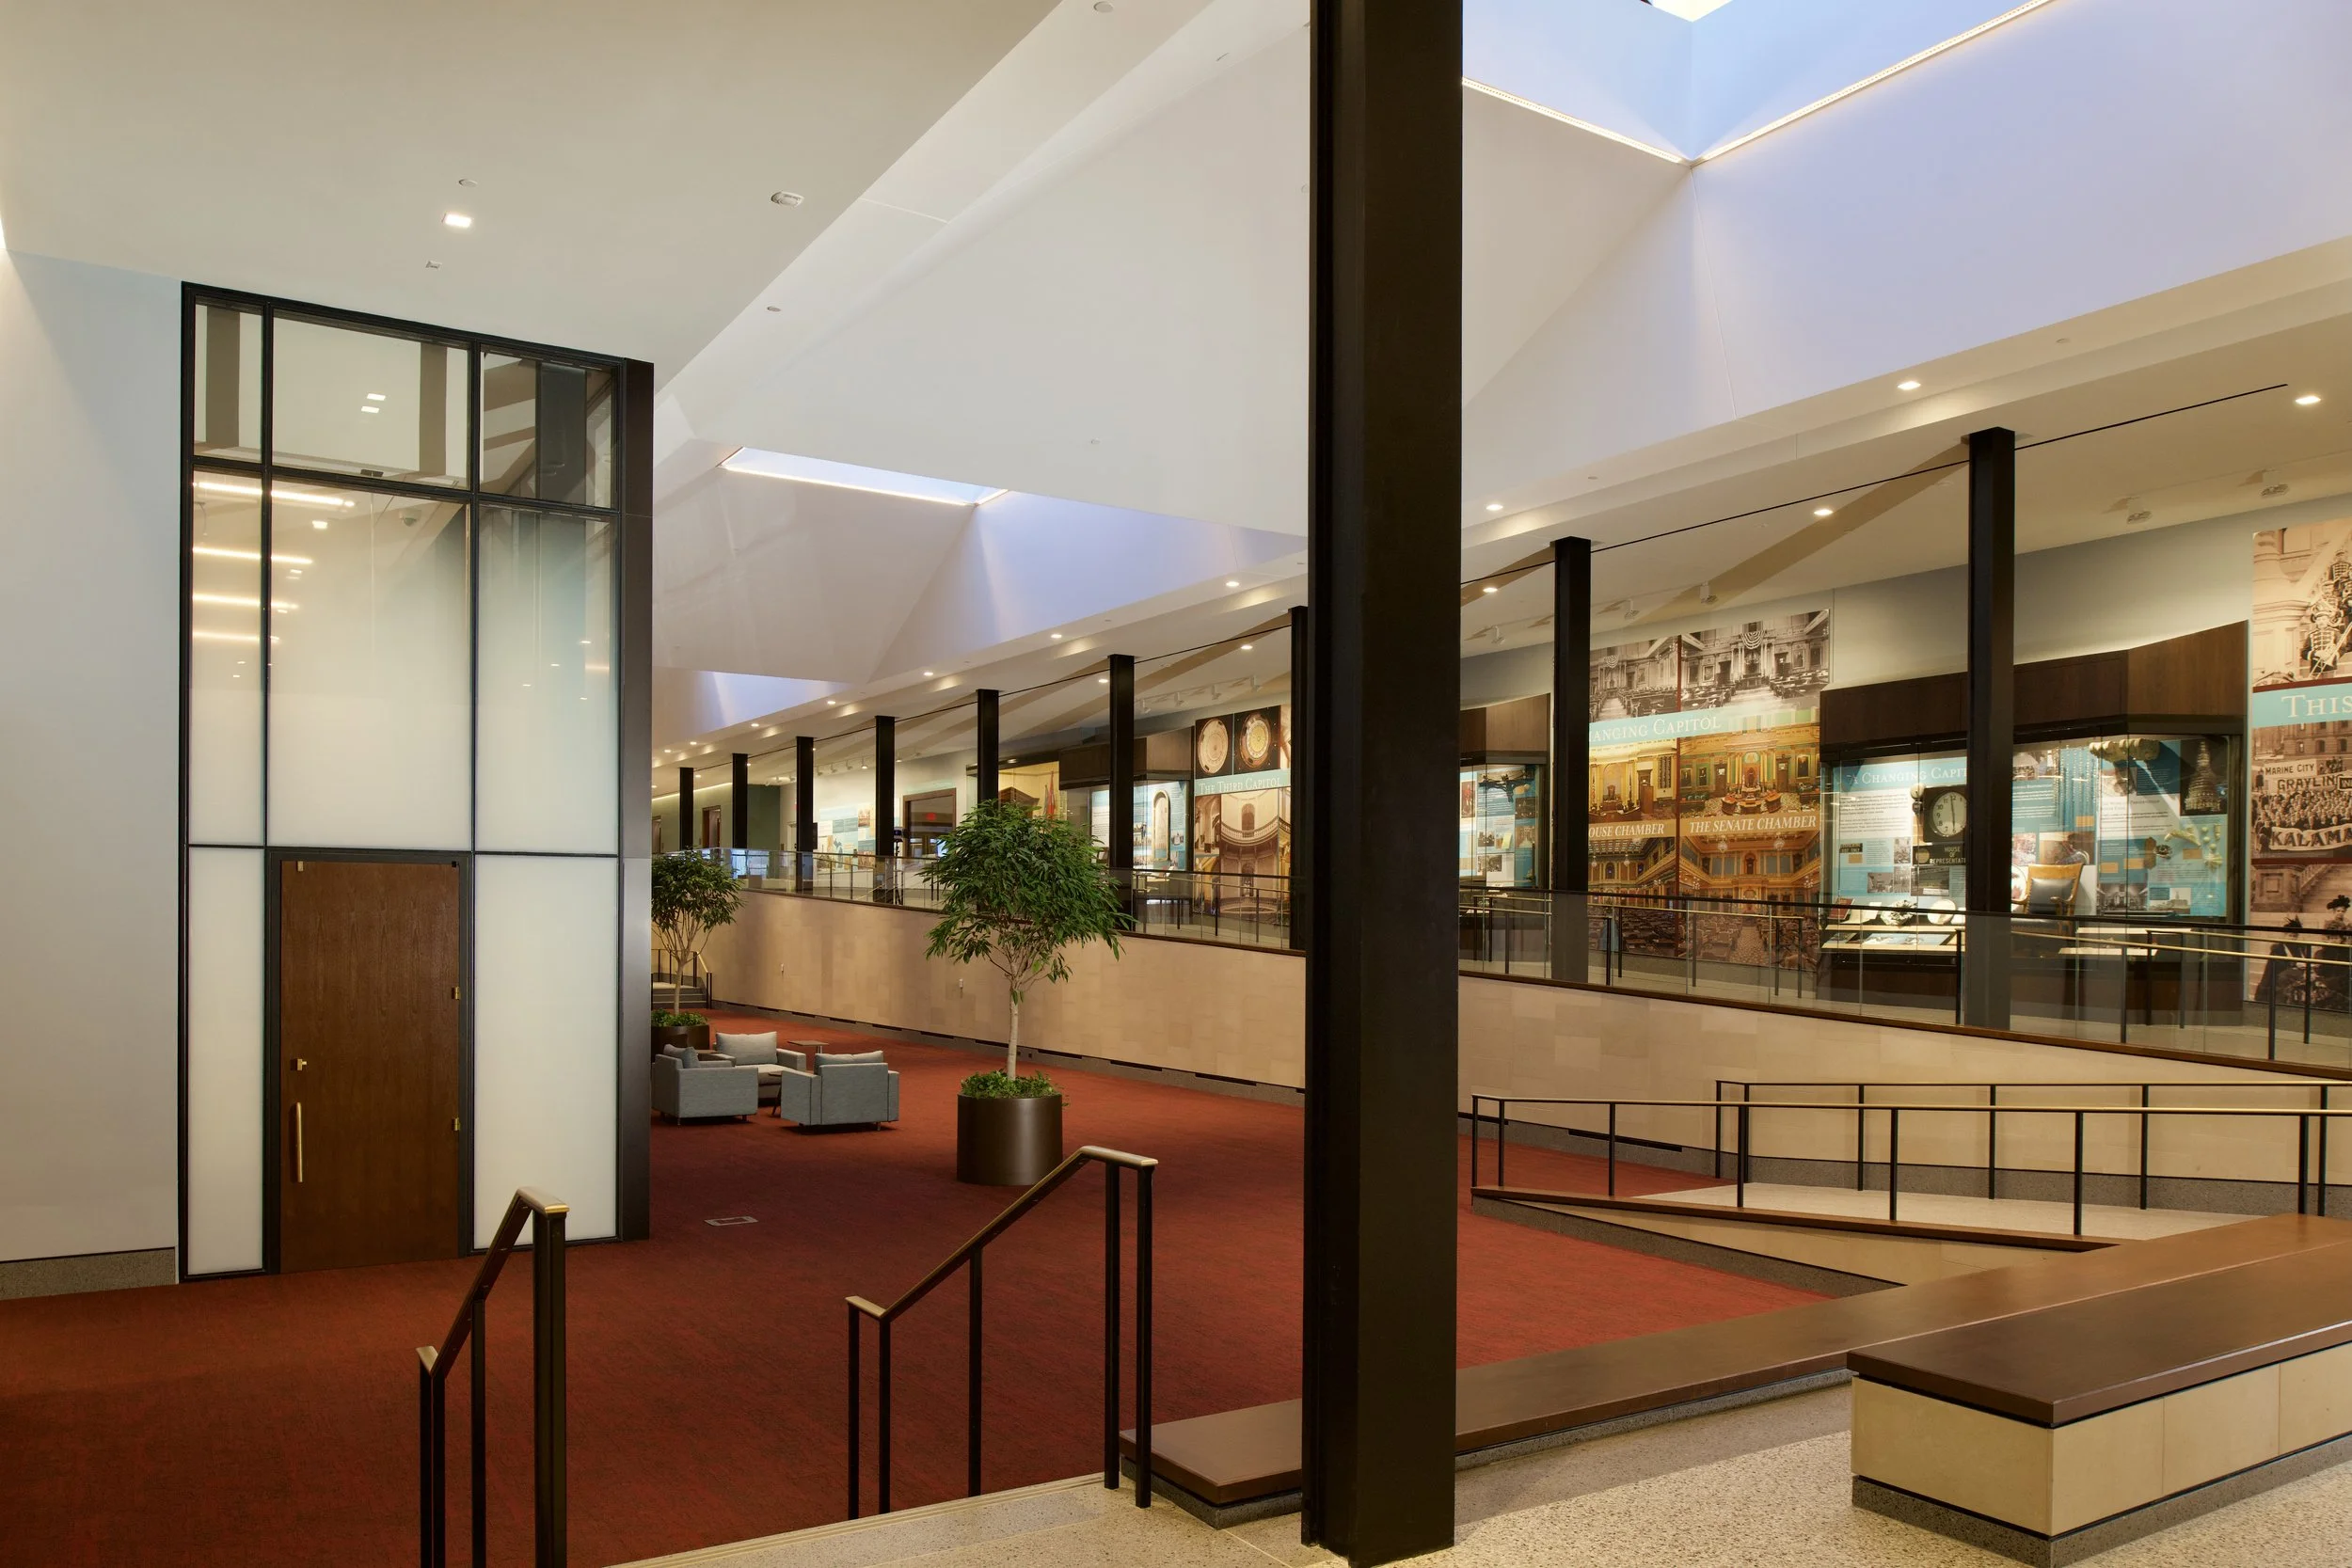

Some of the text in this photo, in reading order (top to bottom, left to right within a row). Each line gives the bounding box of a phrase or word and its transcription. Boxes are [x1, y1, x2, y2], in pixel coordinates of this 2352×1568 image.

[2280, 694, 2352, 719] THIS
[1589, 716, 1721, 742] ANGING CAPITOL
[1862, 770, 1927, 784] CHANGING
[2265, 763, 2314, 775] MARINE CITY
[1200, 777, 1280, 795] THE THIRD CAPITOL
[1614, 823, 1664, 836] CHAMBER
[1690, 816, 1816, 833] THE SENATE CHAMBER
